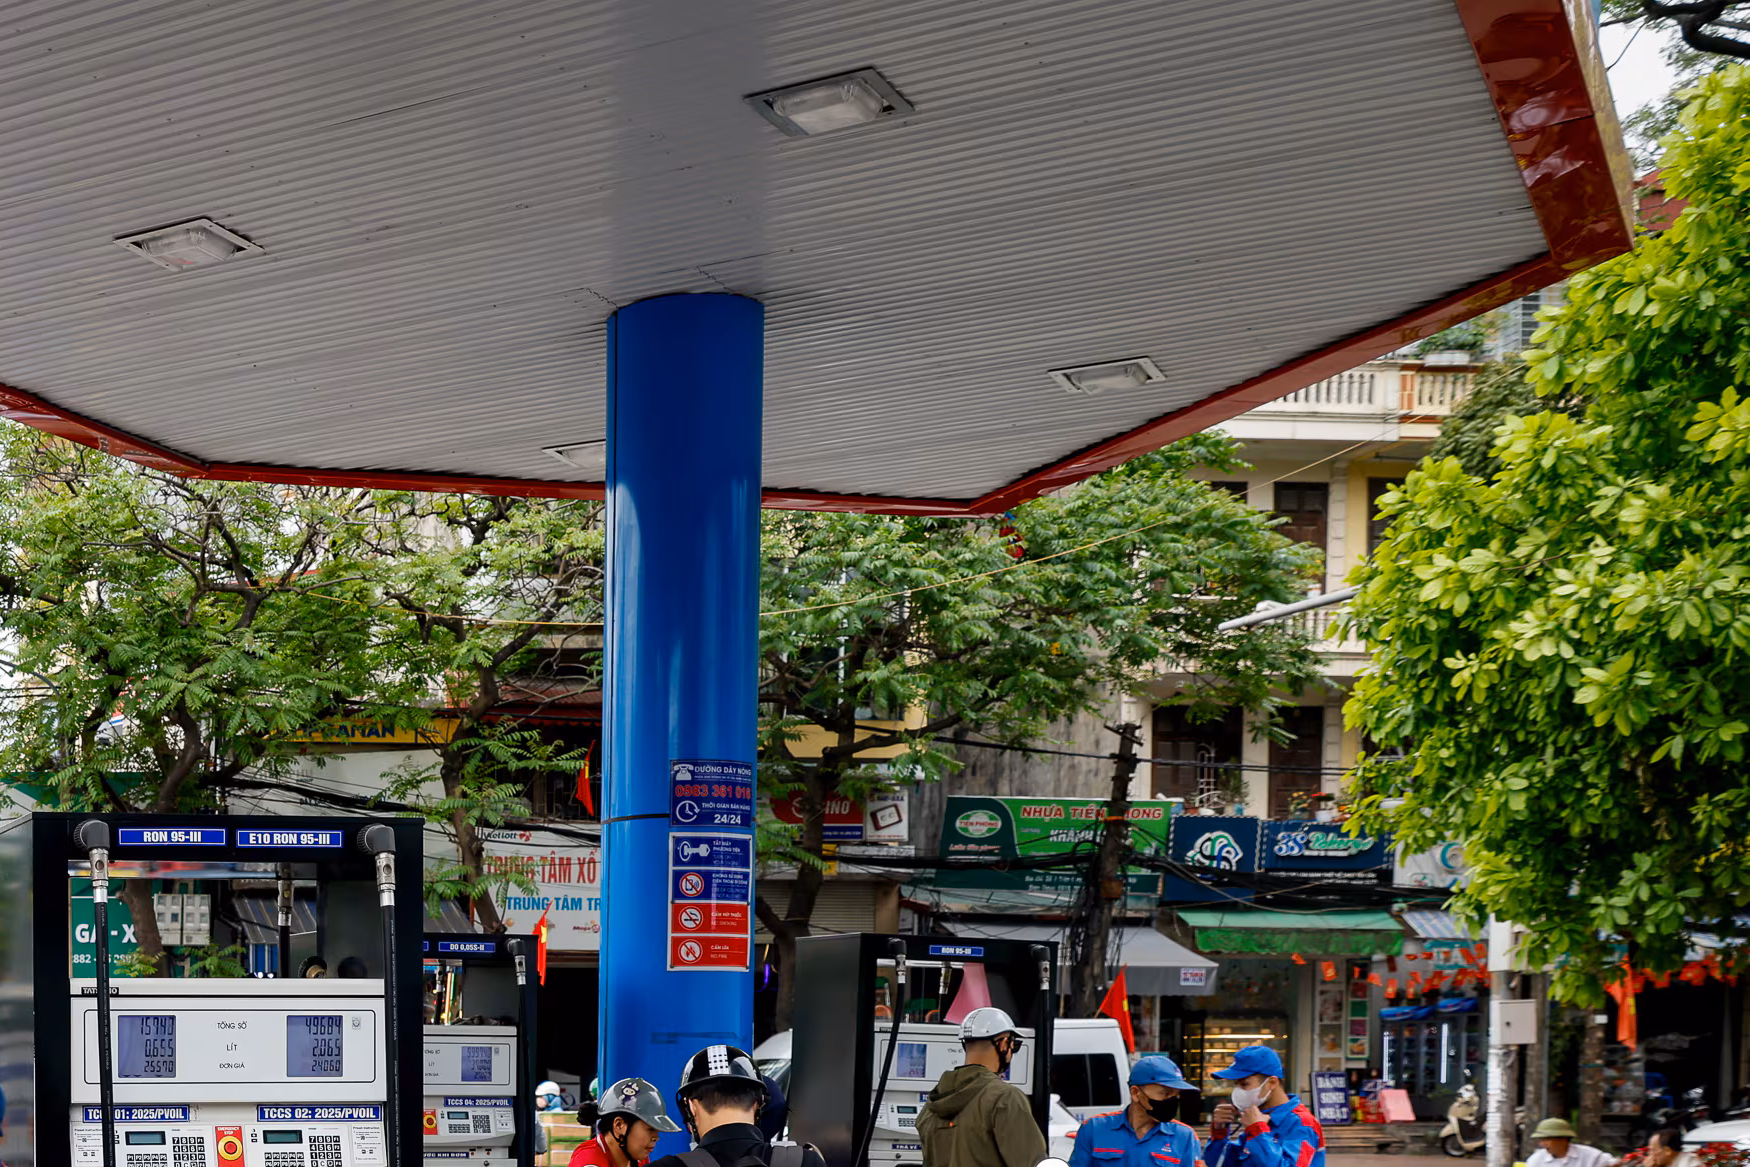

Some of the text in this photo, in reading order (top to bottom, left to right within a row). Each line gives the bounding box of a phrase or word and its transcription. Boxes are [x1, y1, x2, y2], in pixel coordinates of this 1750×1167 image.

[694, 764, 723, 773] ĐƯỜNG
[723, 765, 736, 774] DÂY
[714, 814, 741, 824] 24/24
[143, 831, 203, 843] RON 95-III
[249, 833, 331, 845] E10 RON 95-III
[507, 897, 550, 911] TRUNG
[554, 895, 582, 910] TÂM
[217, 1021, 248, 1029] TỔNG SỐ
[226, 1043, 238, 1052] LÍT
[115, 1109, 184, 1119] 01: 2025/PVOIL
[264, 1108, 376, 1118] TCCS 02: 2025/PVOIL
